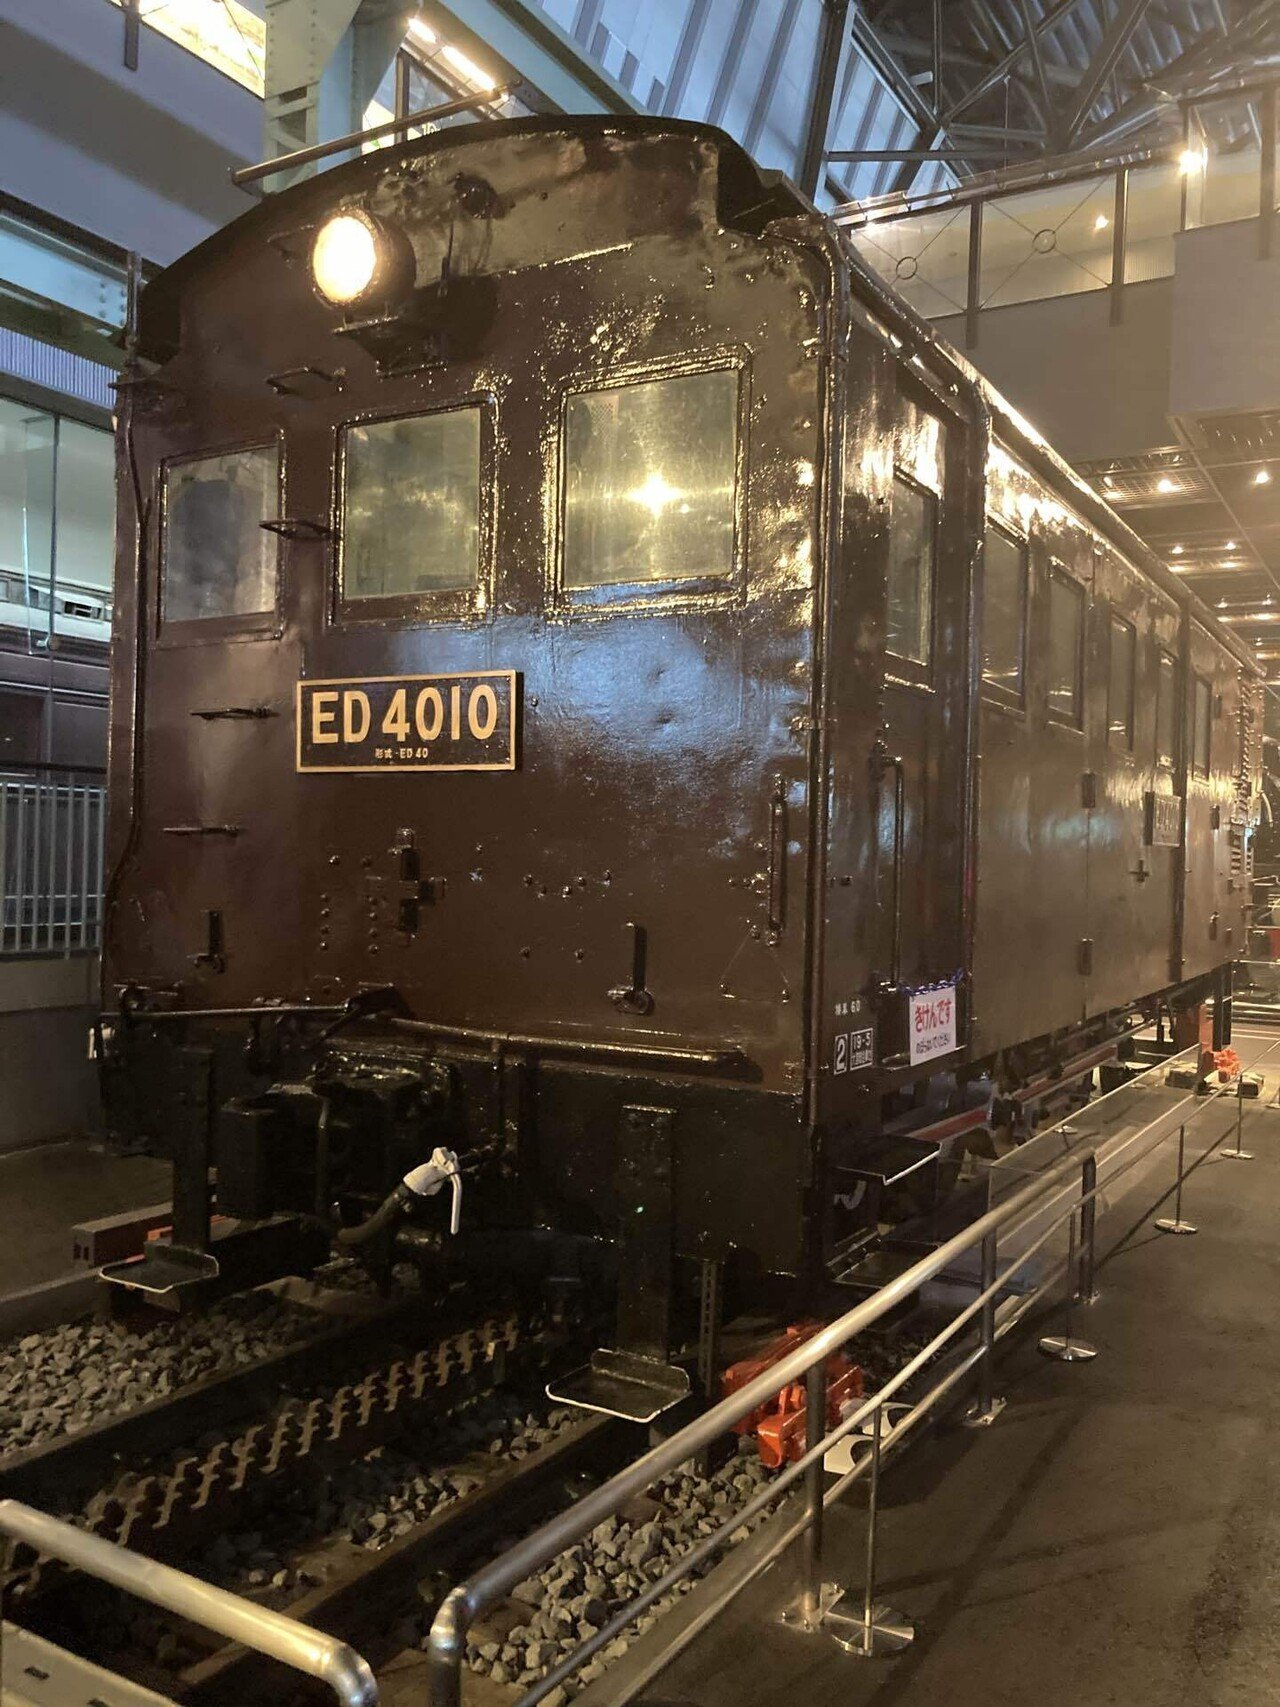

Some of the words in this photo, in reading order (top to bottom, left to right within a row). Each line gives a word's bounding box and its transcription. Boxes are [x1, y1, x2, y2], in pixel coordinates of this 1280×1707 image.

[312, 690, 371, 744] ED
[382, 684, 498, 742] 4010
[400, 748, 413, 758] ED
[415, 748, 429, 758] 40
[915, 998, 952, 1033] きけんです
[837, 1038, 846, 1068] 2
